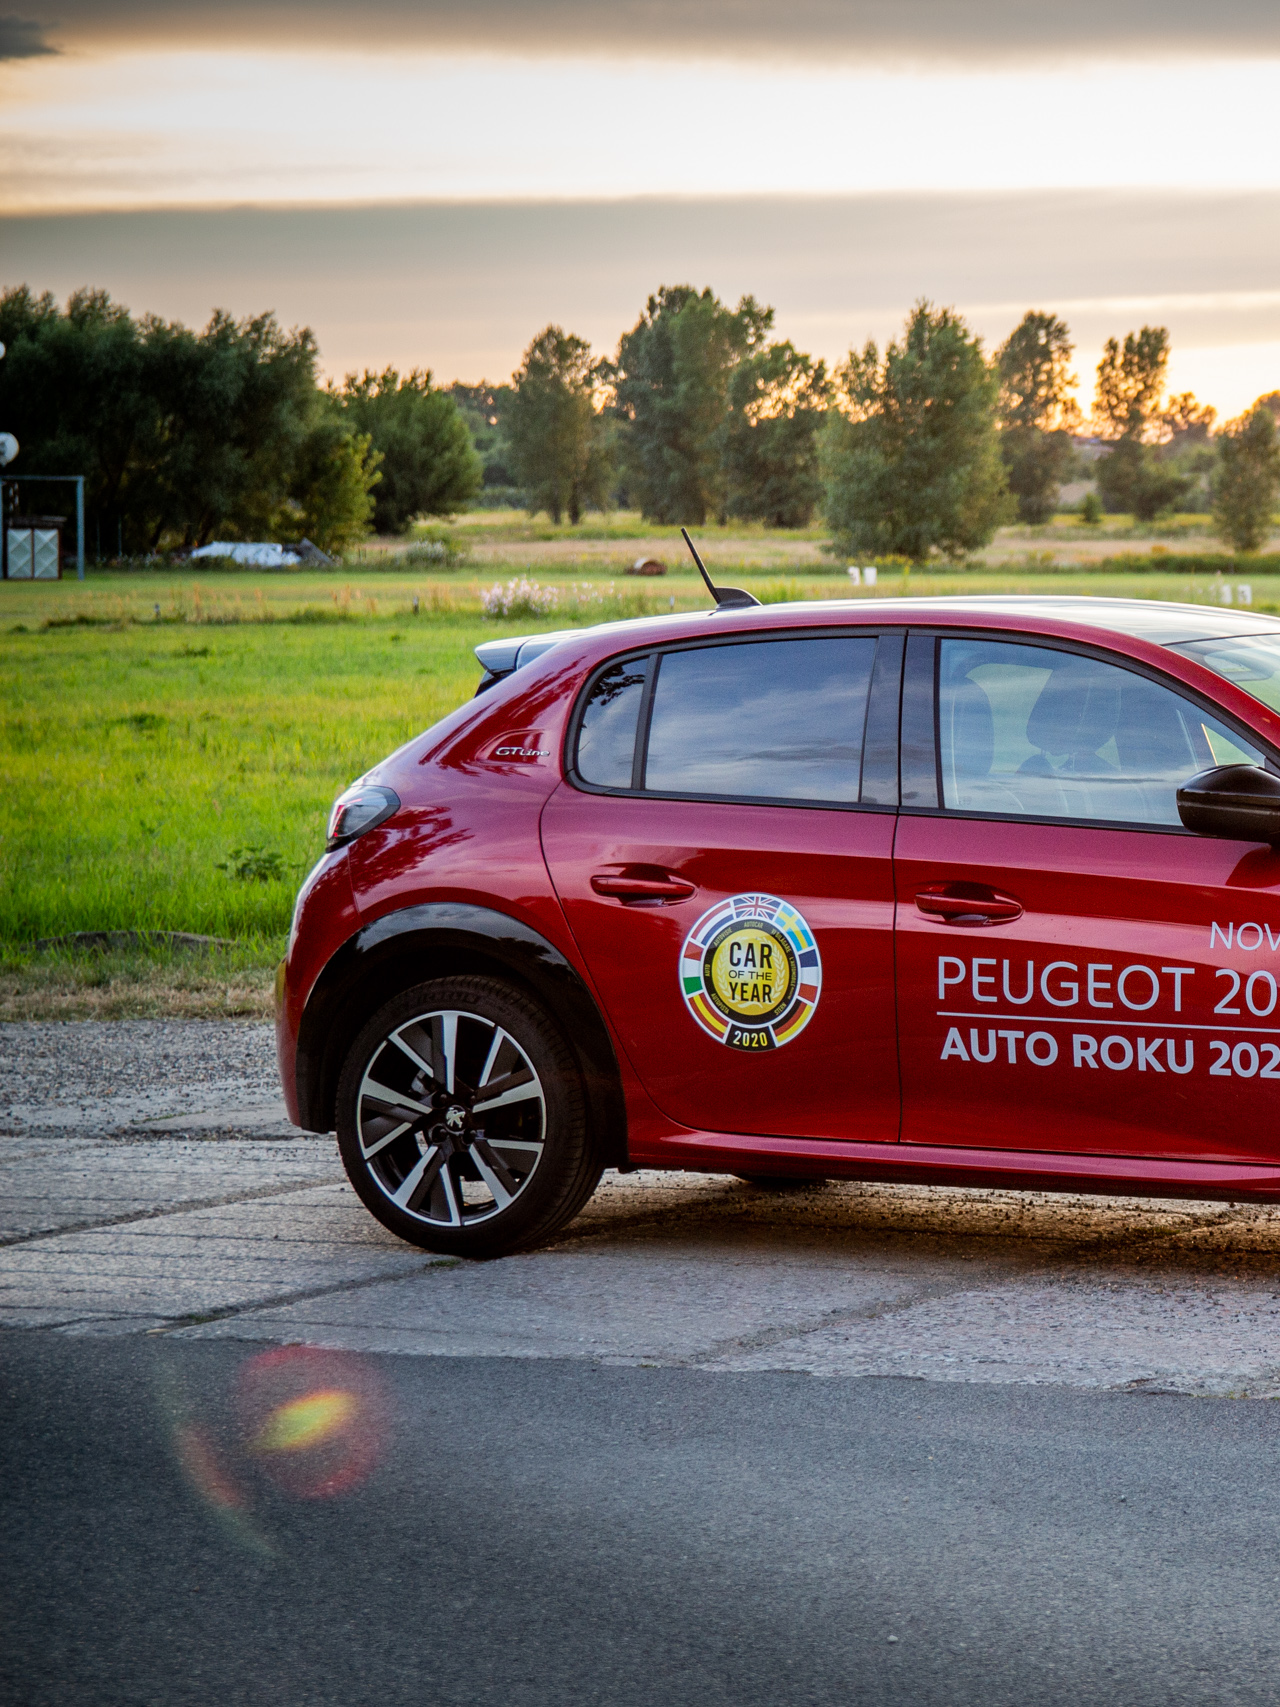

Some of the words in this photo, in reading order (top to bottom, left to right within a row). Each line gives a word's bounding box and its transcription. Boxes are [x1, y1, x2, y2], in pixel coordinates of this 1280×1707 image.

[729, 941, 772, 969] CAR
[728, 970, 745, 979] OF
[748, 970, 773, 981] THE
[937, 955, 1195, 1012] PEUGEOT
[729, 981, 773, 1004] YEAR
[774, 1002, 787, 1016] STERN
[733, 1030, 768, 1047] 2020
[940, 1027, 1059, 1067] AUTO
[1073, 1033, 1195, 1075] ROKU
